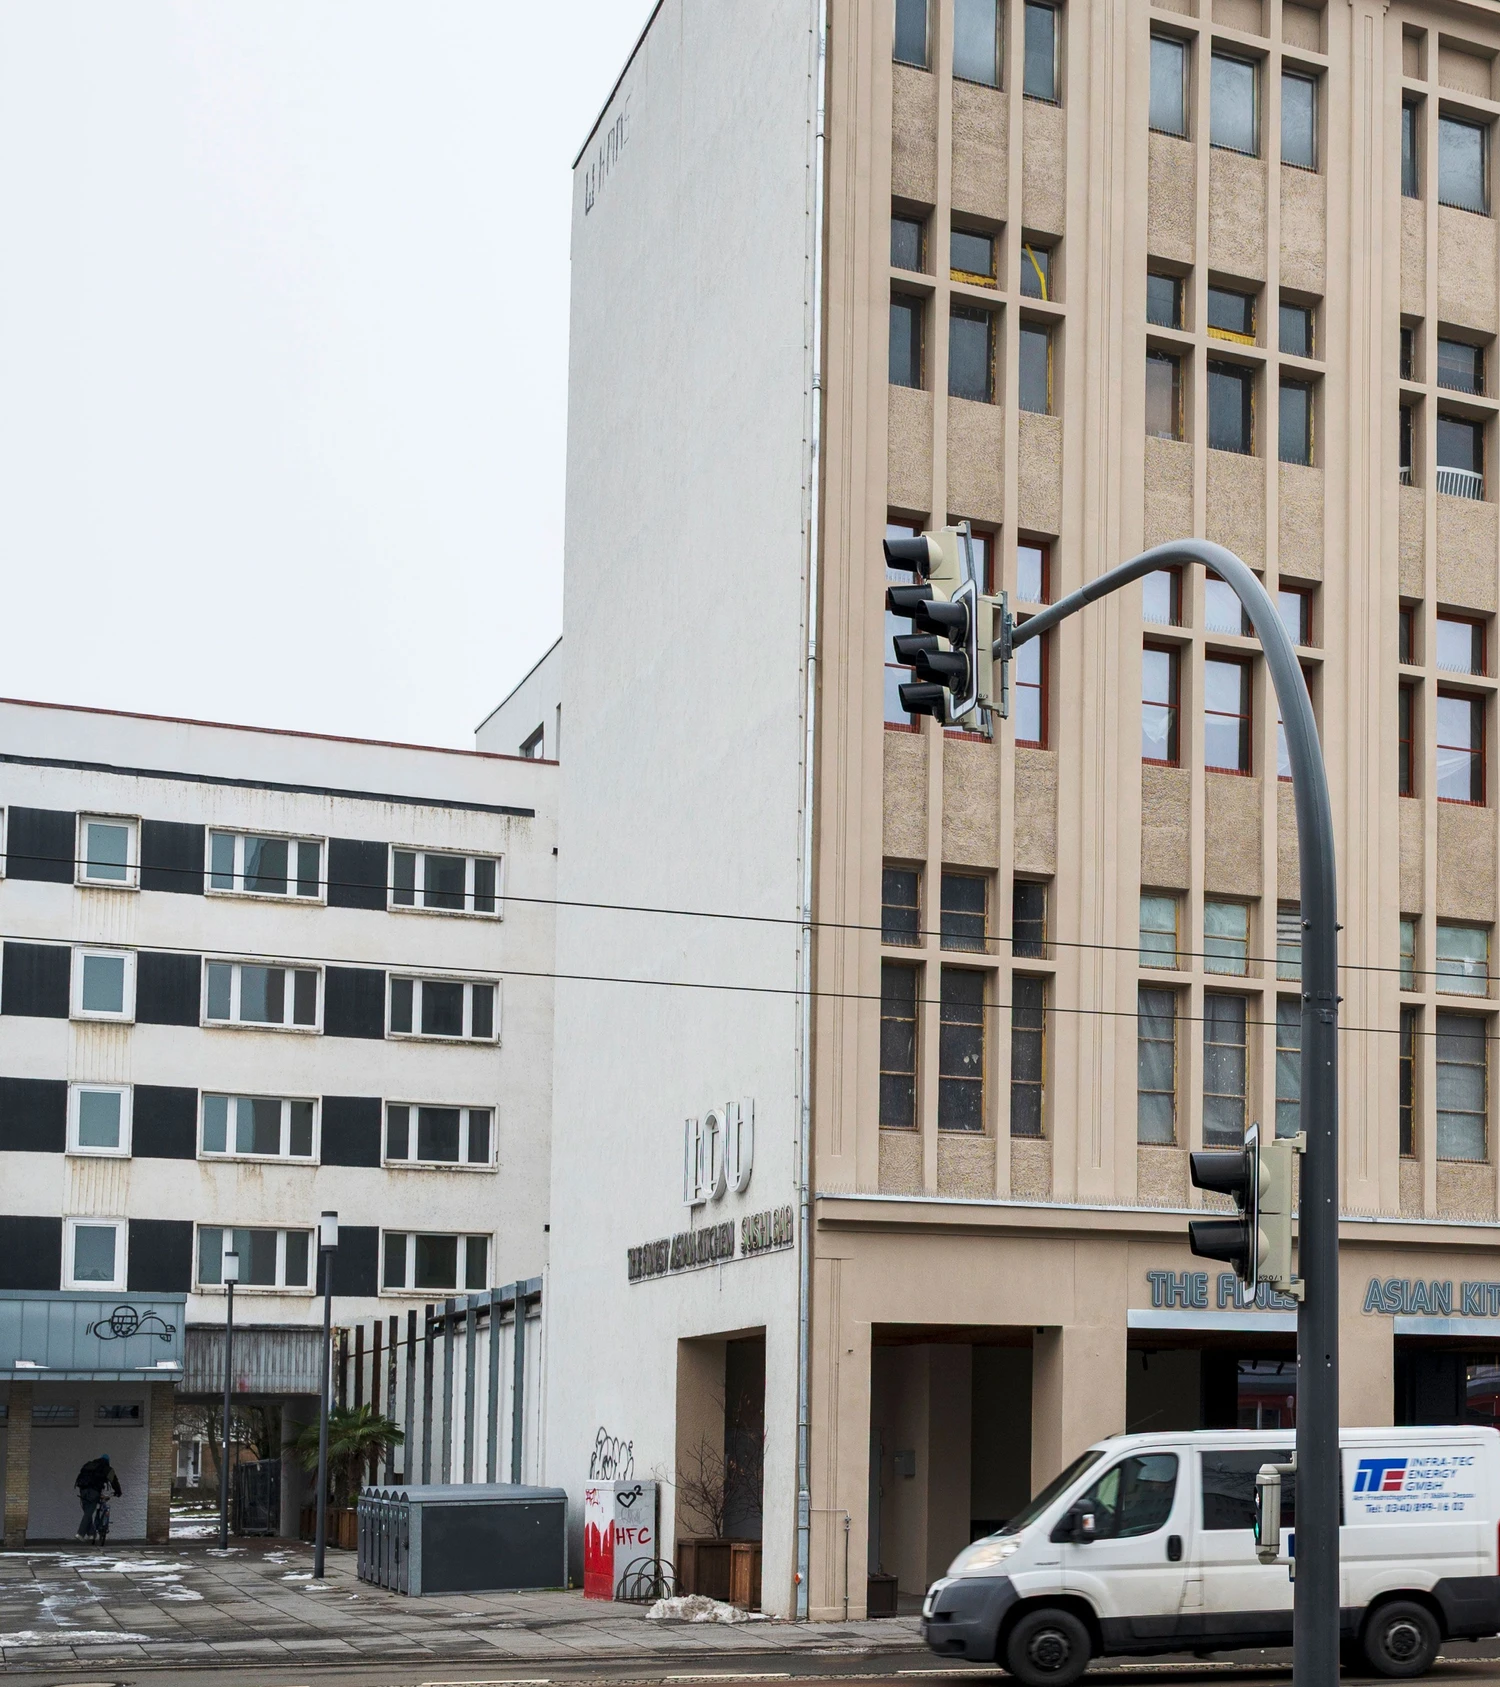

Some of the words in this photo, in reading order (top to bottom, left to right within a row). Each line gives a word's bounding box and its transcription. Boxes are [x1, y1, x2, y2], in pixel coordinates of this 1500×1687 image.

[741, 1209, 773, 1254] SUSHI
[773, 1202, 795, 1248] BAR
[1148, 1270, 1208, 1308] THE
[1217, 1272, 1299, 1310] FINES
[1364, 1278, 1453, 1315] ASIAN
[1407, 1469, 1458, 1479] ENERGY
[1410, 1456, 1475, 1467] INFRA-TEC
[616, 1527, 652, 1546] HFC
